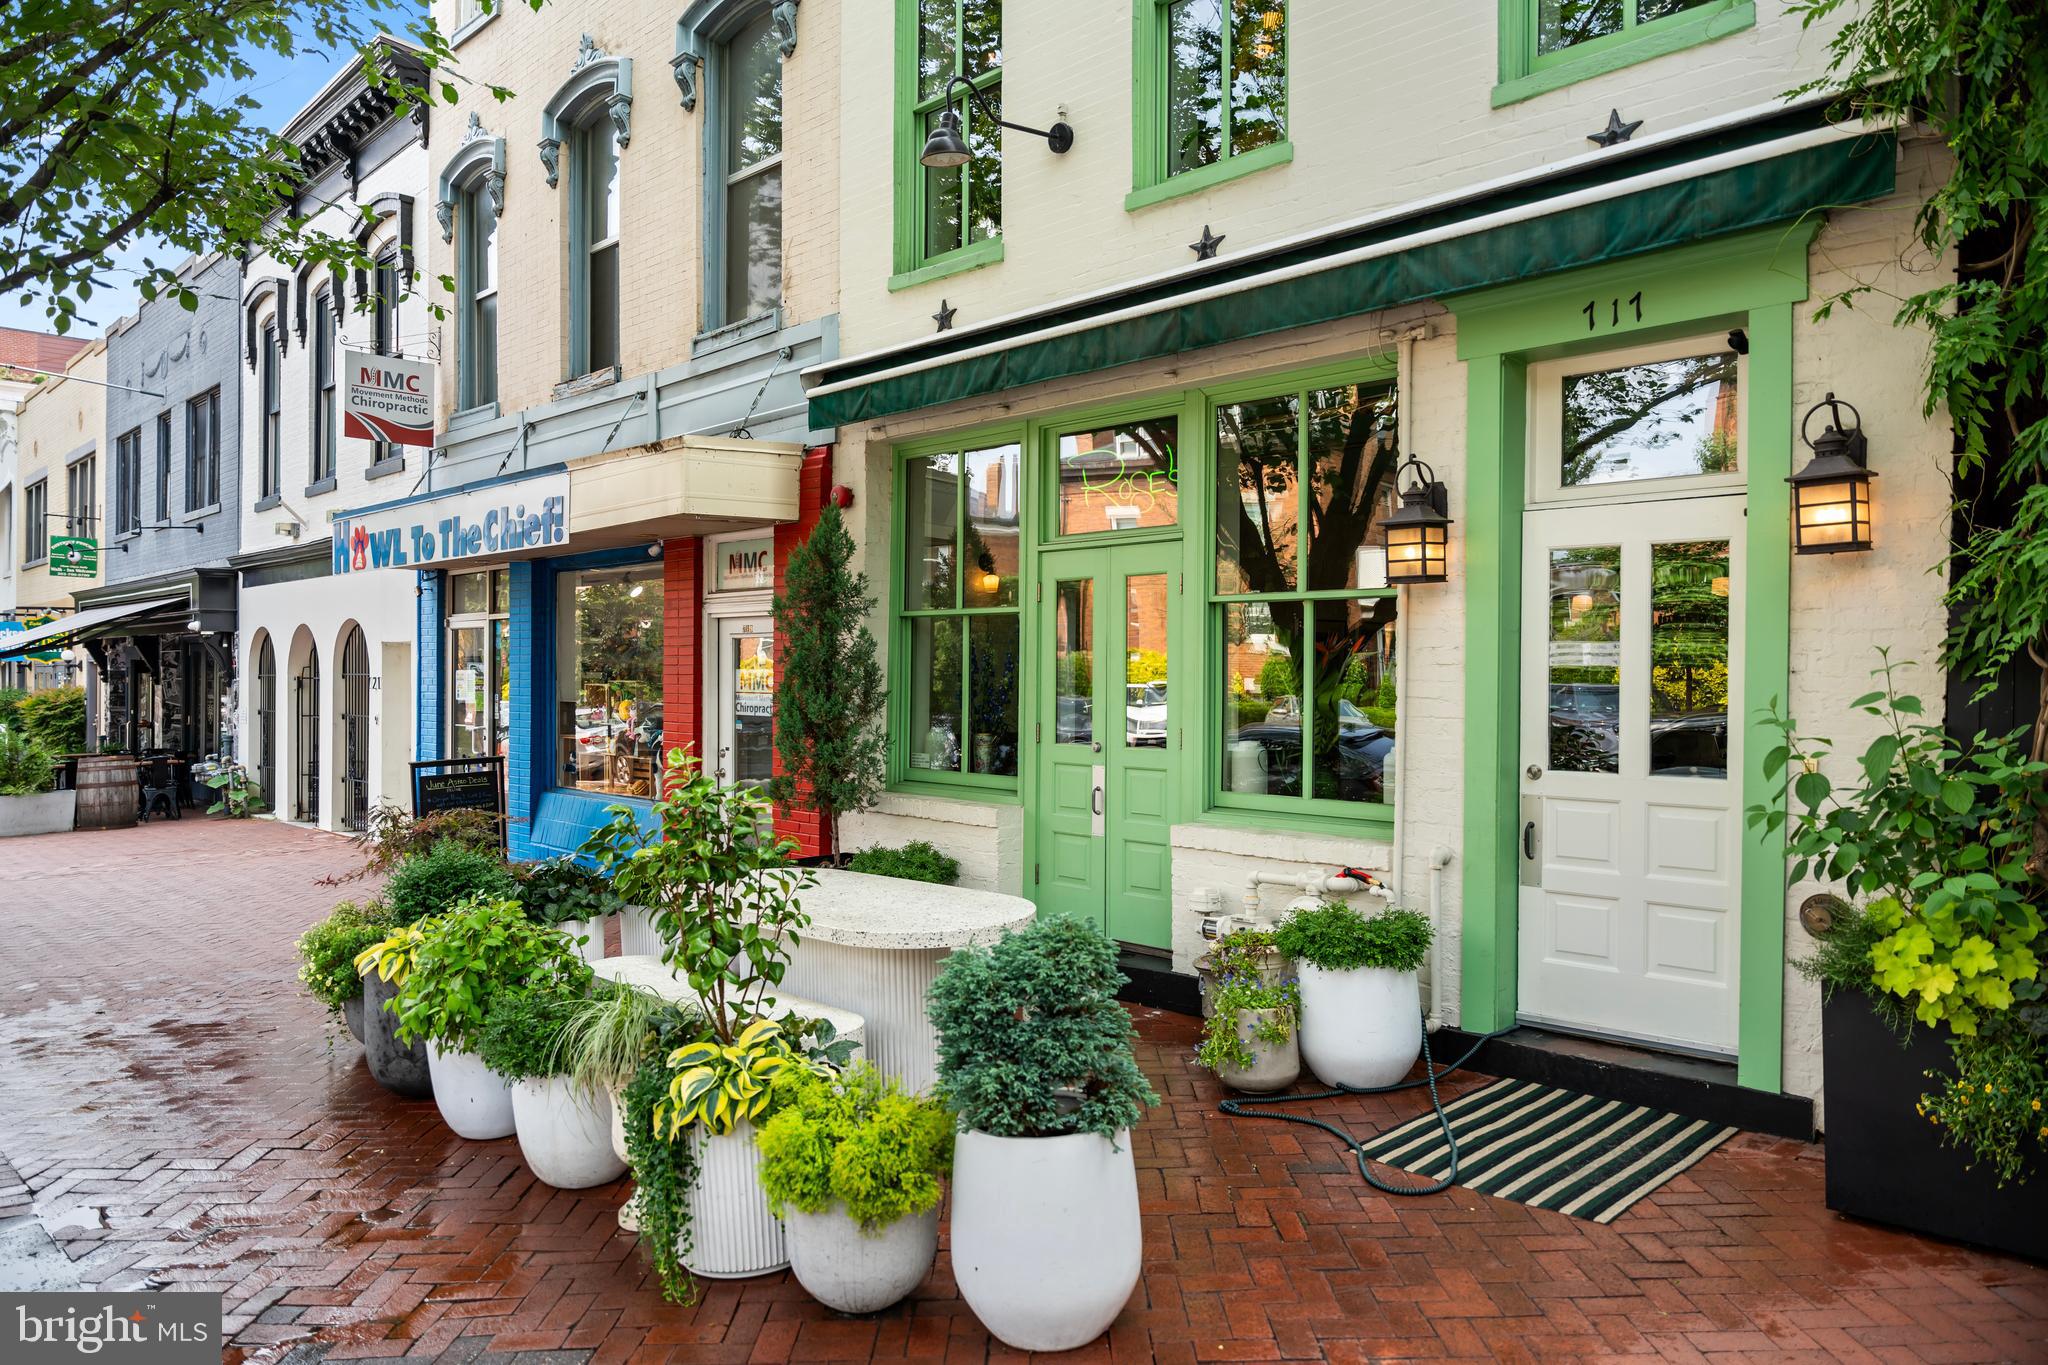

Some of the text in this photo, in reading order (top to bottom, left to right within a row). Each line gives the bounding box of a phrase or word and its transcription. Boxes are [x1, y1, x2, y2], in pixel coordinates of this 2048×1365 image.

[360, 367, 420, 393] MMC
[351, 387, 428, 405] Movement Methods
[351, 395, 428, 416] Chiropractic
[411, 525, 435, 563] To
[439, 516, 482, 559] The
[483, 496, 564, 552] Chief!
[729, 550, 768, 575] MMC
[426, 779, 445, 791] June
[468, 776, 488, 785] Deals
